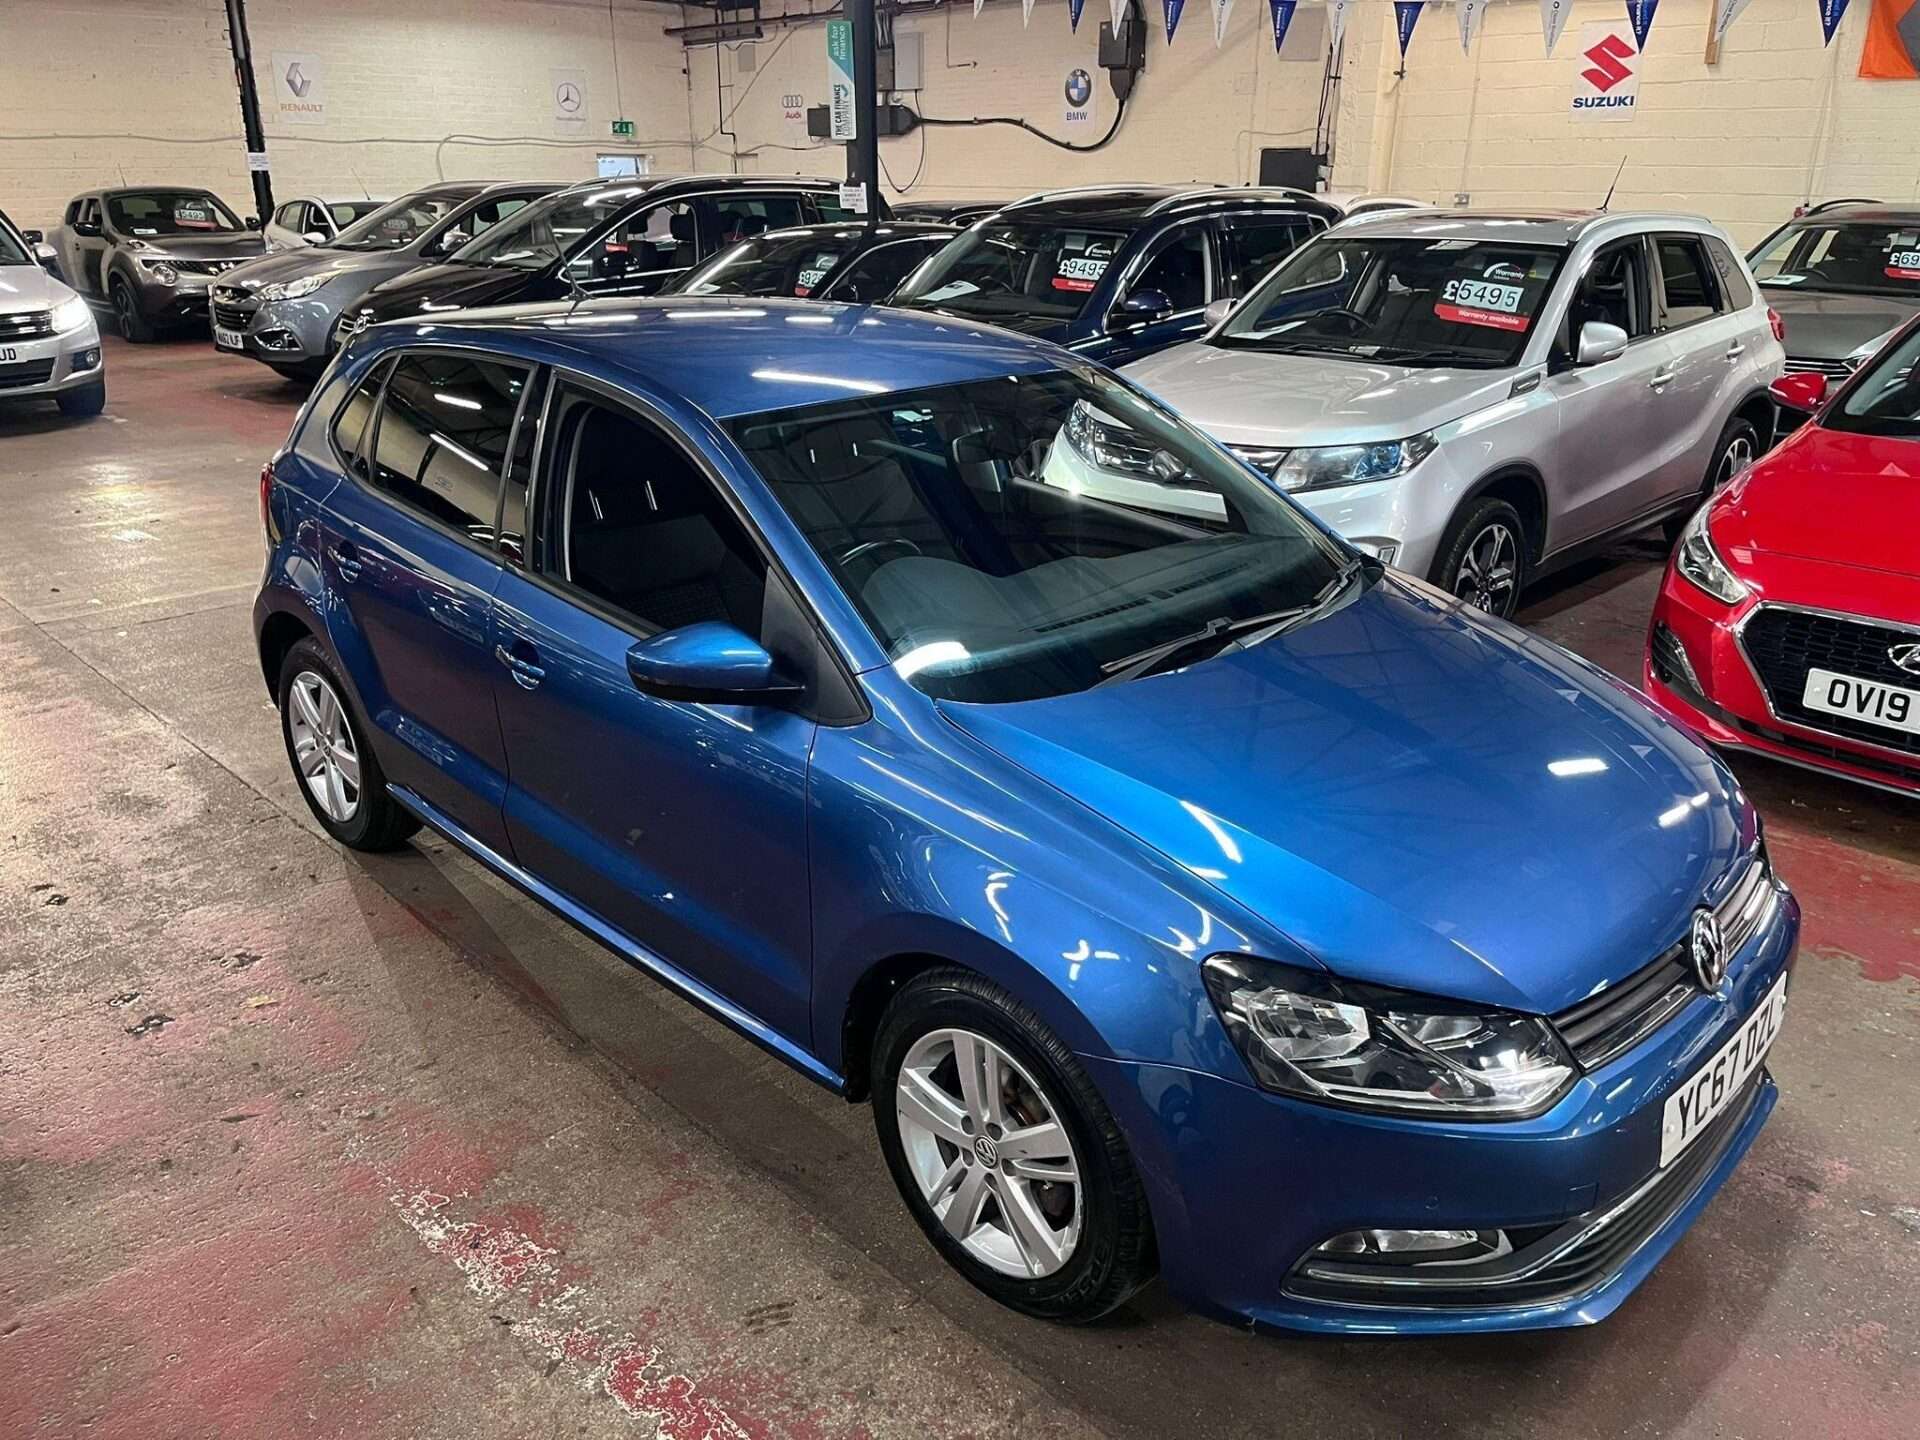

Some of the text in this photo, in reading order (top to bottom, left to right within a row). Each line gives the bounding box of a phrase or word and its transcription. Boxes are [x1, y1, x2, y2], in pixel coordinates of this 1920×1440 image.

[280, 103, 323, 113] RENAULT
[1572, 95, 1635, 109] SUZUKI
[1066, 111, 1088, 121] BMW
[1442, 280, 1518, 308] £5495
[1827, 679, 1911, 723] OV19
[1678, 997, 1775, 1141] YC67 DZL
